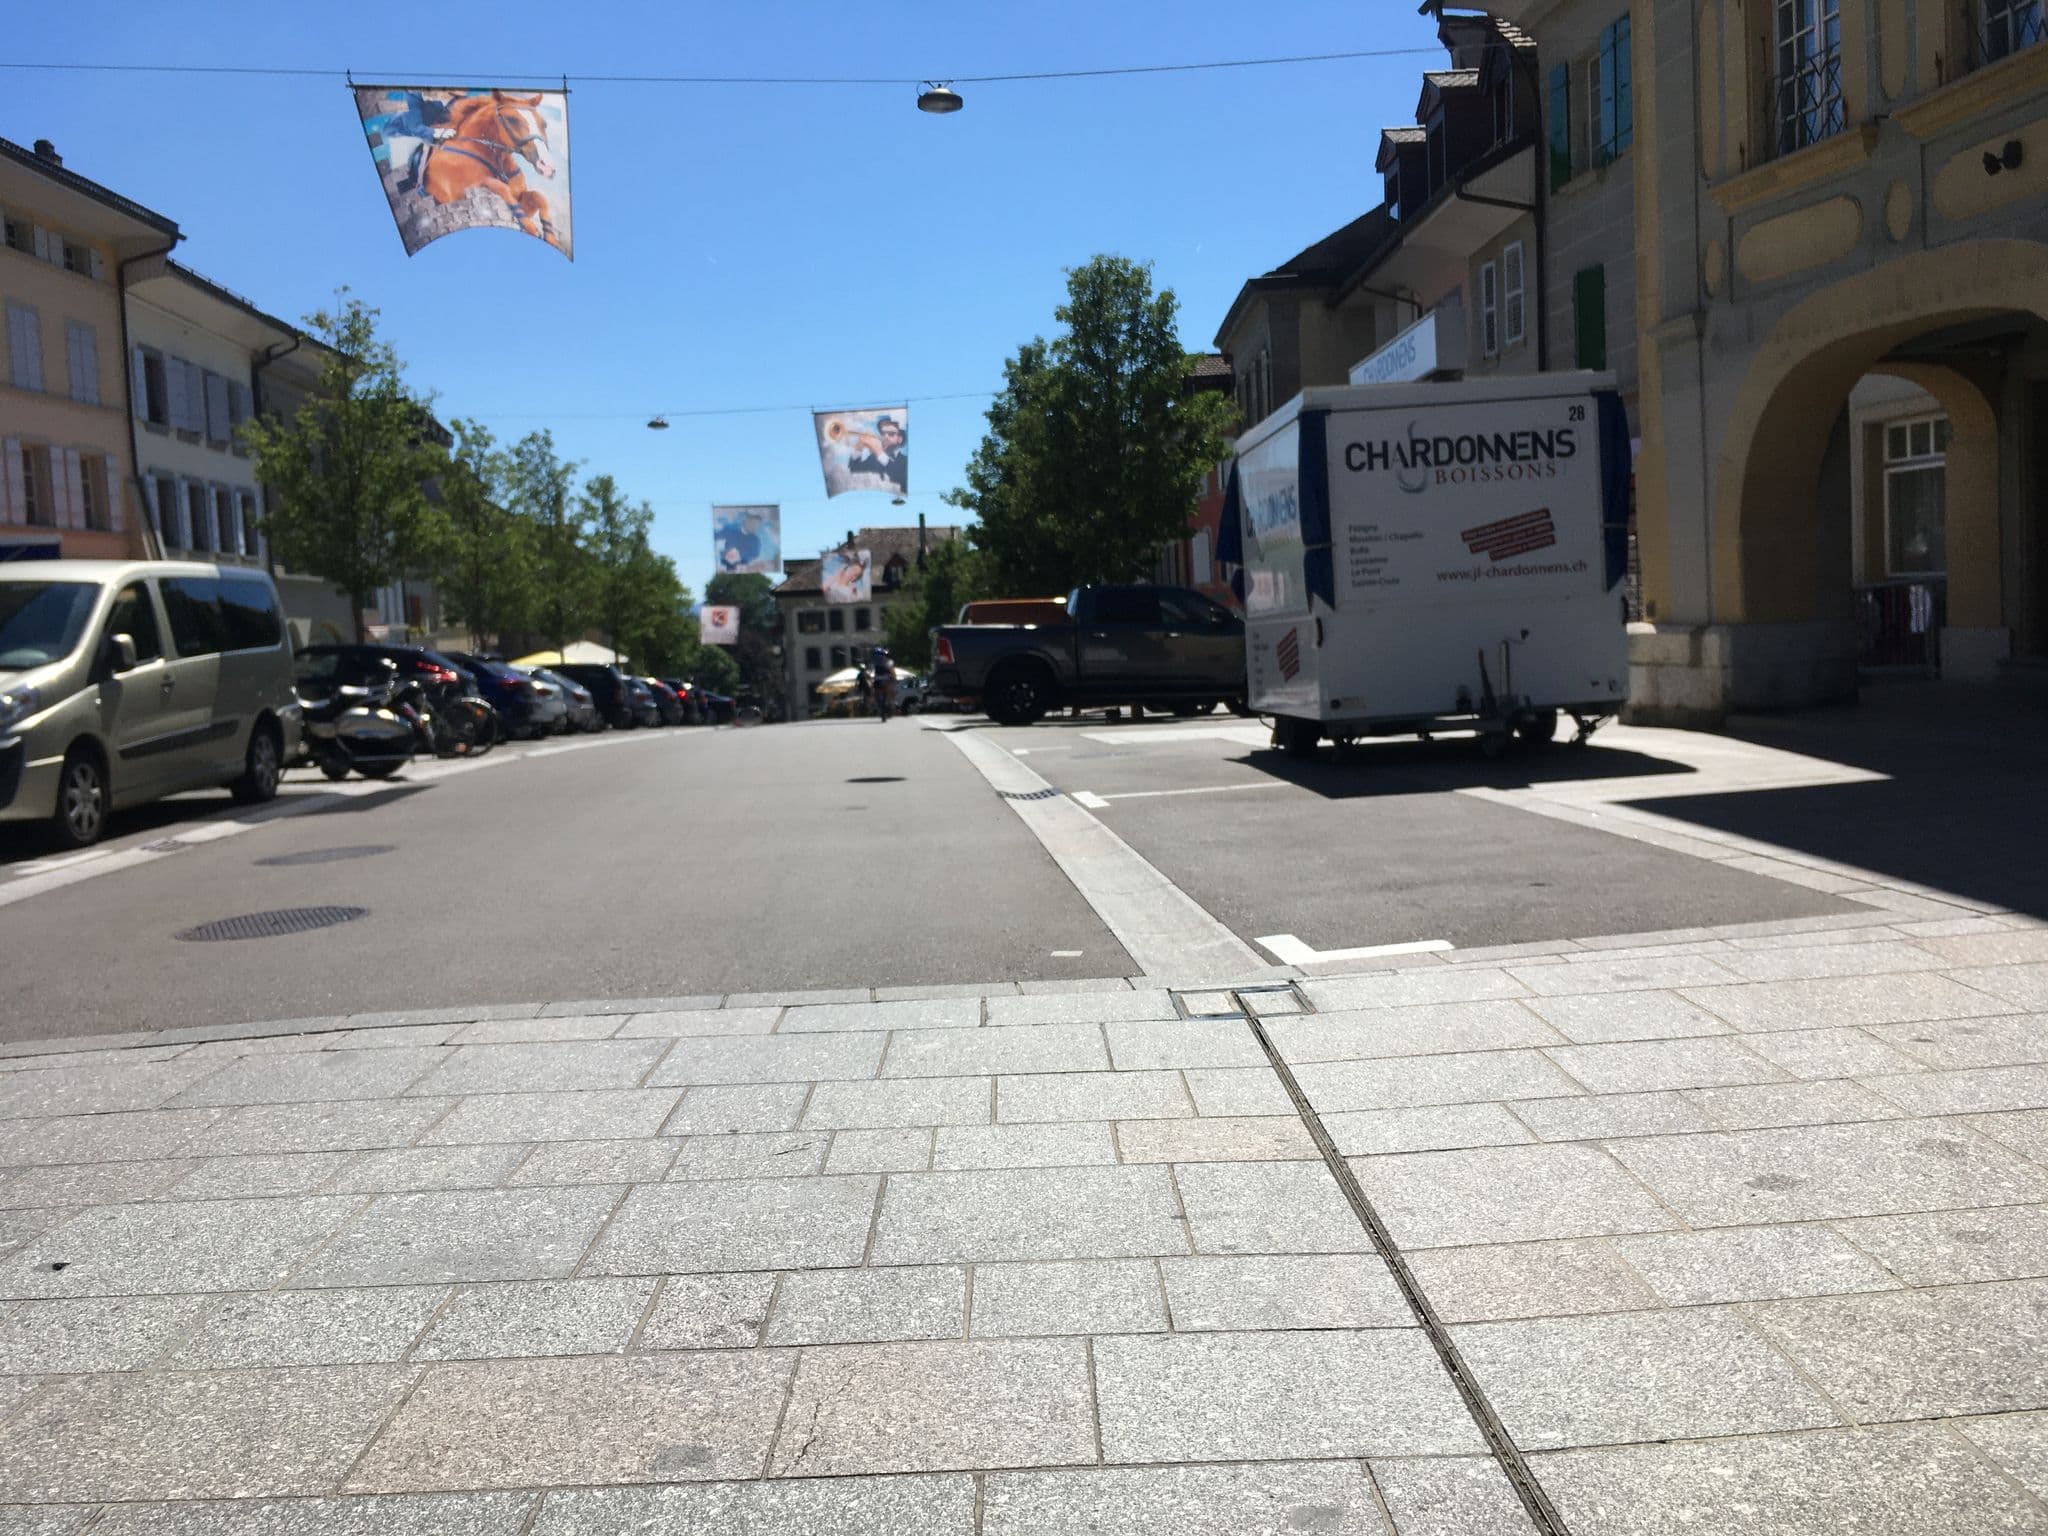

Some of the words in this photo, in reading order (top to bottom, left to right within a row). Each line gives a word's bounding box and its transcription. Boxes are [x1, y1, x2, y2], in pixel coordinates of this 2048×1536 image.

[1568, 405, 1586, 422] 28
[1345, 429, 1577, 472] CHARDONNENS
[1435, 462, 1557, 485] BOISSONS
